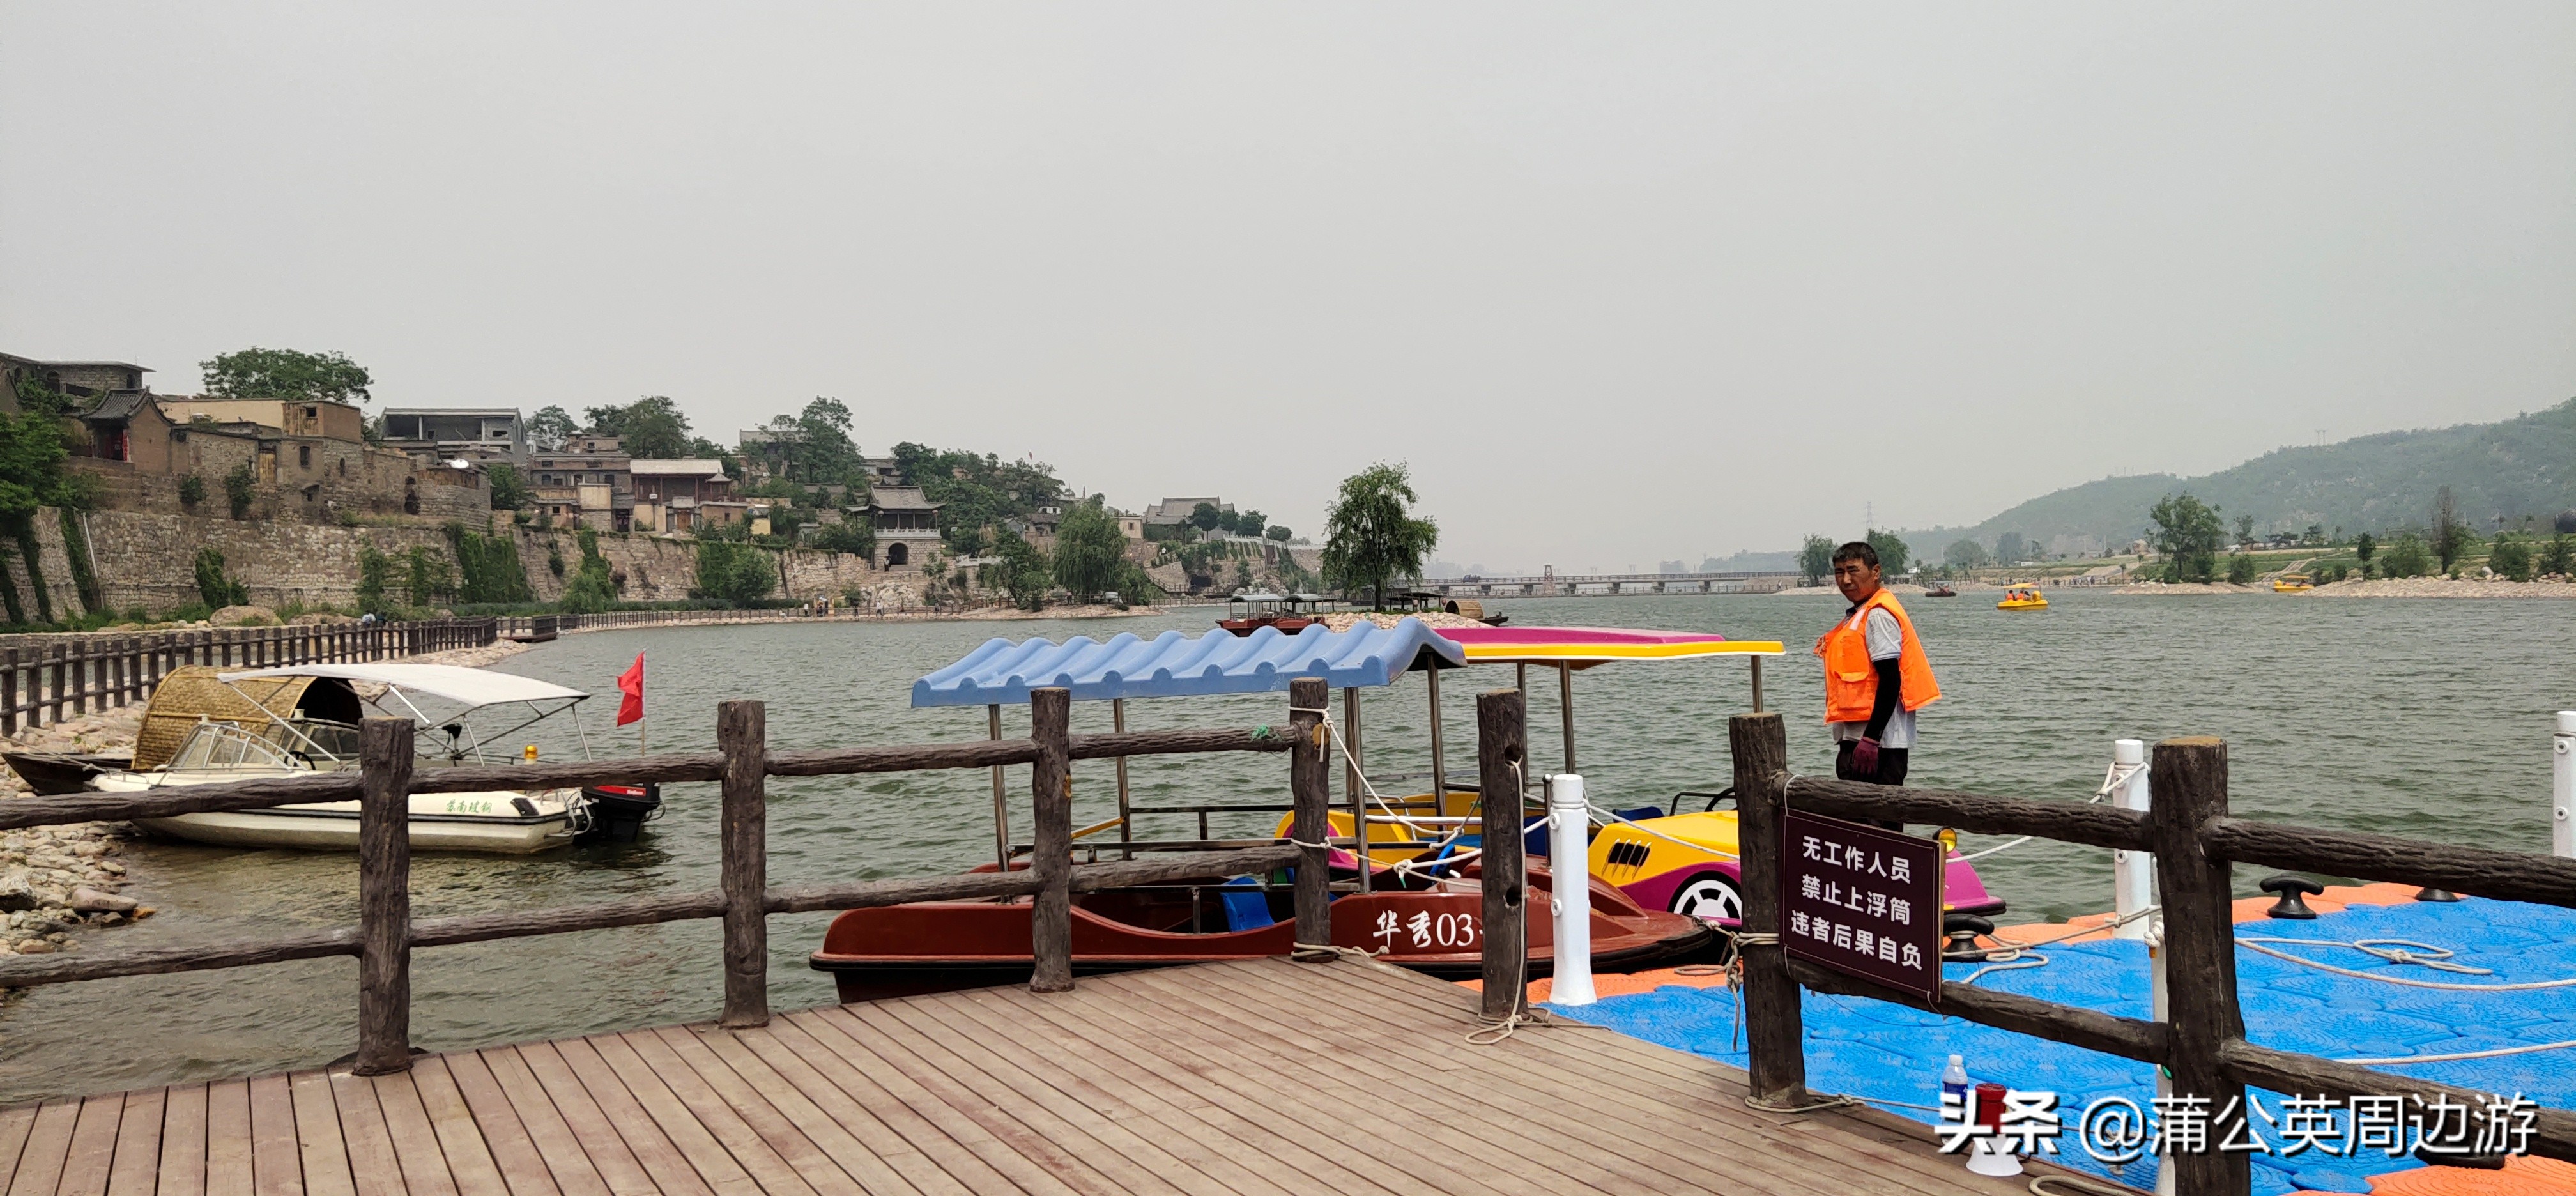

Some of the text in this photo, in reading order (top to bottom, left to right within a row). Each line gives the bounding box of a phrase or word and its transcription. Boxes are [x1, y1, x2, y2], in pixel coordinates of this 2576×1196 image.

[1802, 835, 1911, 884] 无工作人员
[1802, 873, 1911, 925] 禁止上浮筒
[1373, 909, 1483, 947] 华秀03
[1791, 909, 1922, 971] 违者后果自负
